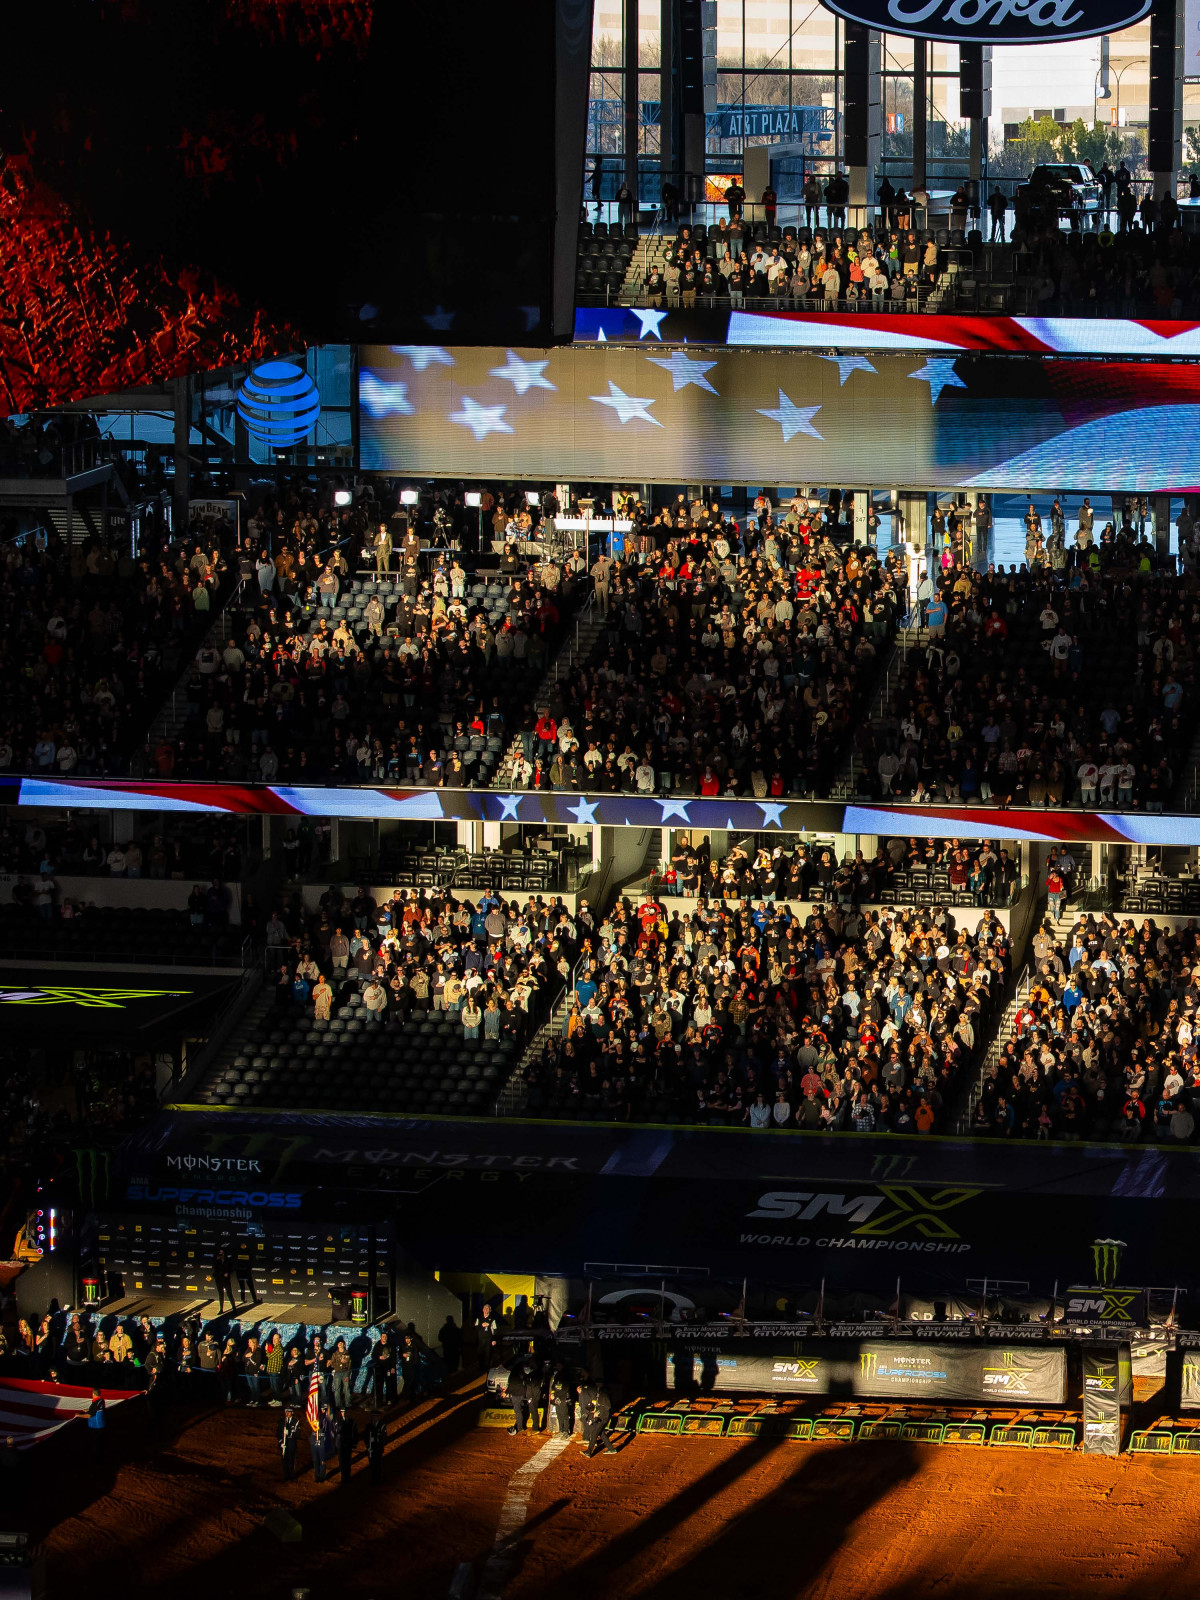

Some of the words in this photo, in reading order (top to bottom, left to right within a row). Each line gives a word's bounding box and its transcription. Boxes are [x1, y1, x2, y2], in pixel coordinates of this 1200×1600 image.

[729, 114, 757, 136] AT&T
[761, 112, 799, 134] PLAZA
[166, 1154, 263, 1174] MONSTER
[312, 1148, 580, 1170] MONSTER
[130, 1177, 150, 1186] AMA
[127, 1184, 304, 1209] SUPERCROSS
[175, 1204, 253, 1220] Championship
[744, 1184, 985, 1239] SMX
[739, 1232, 812, 1248] WORLD
[815, 1236, 973, 1255] CHAMPIONSHIP
[1066, 1294, 1136, 1320] SMX
[771, 1360, 820, 1378] SMX
[893, 1356, 932, 1365] MONSTER
[983, 1372, 1031, 1389] SMX
